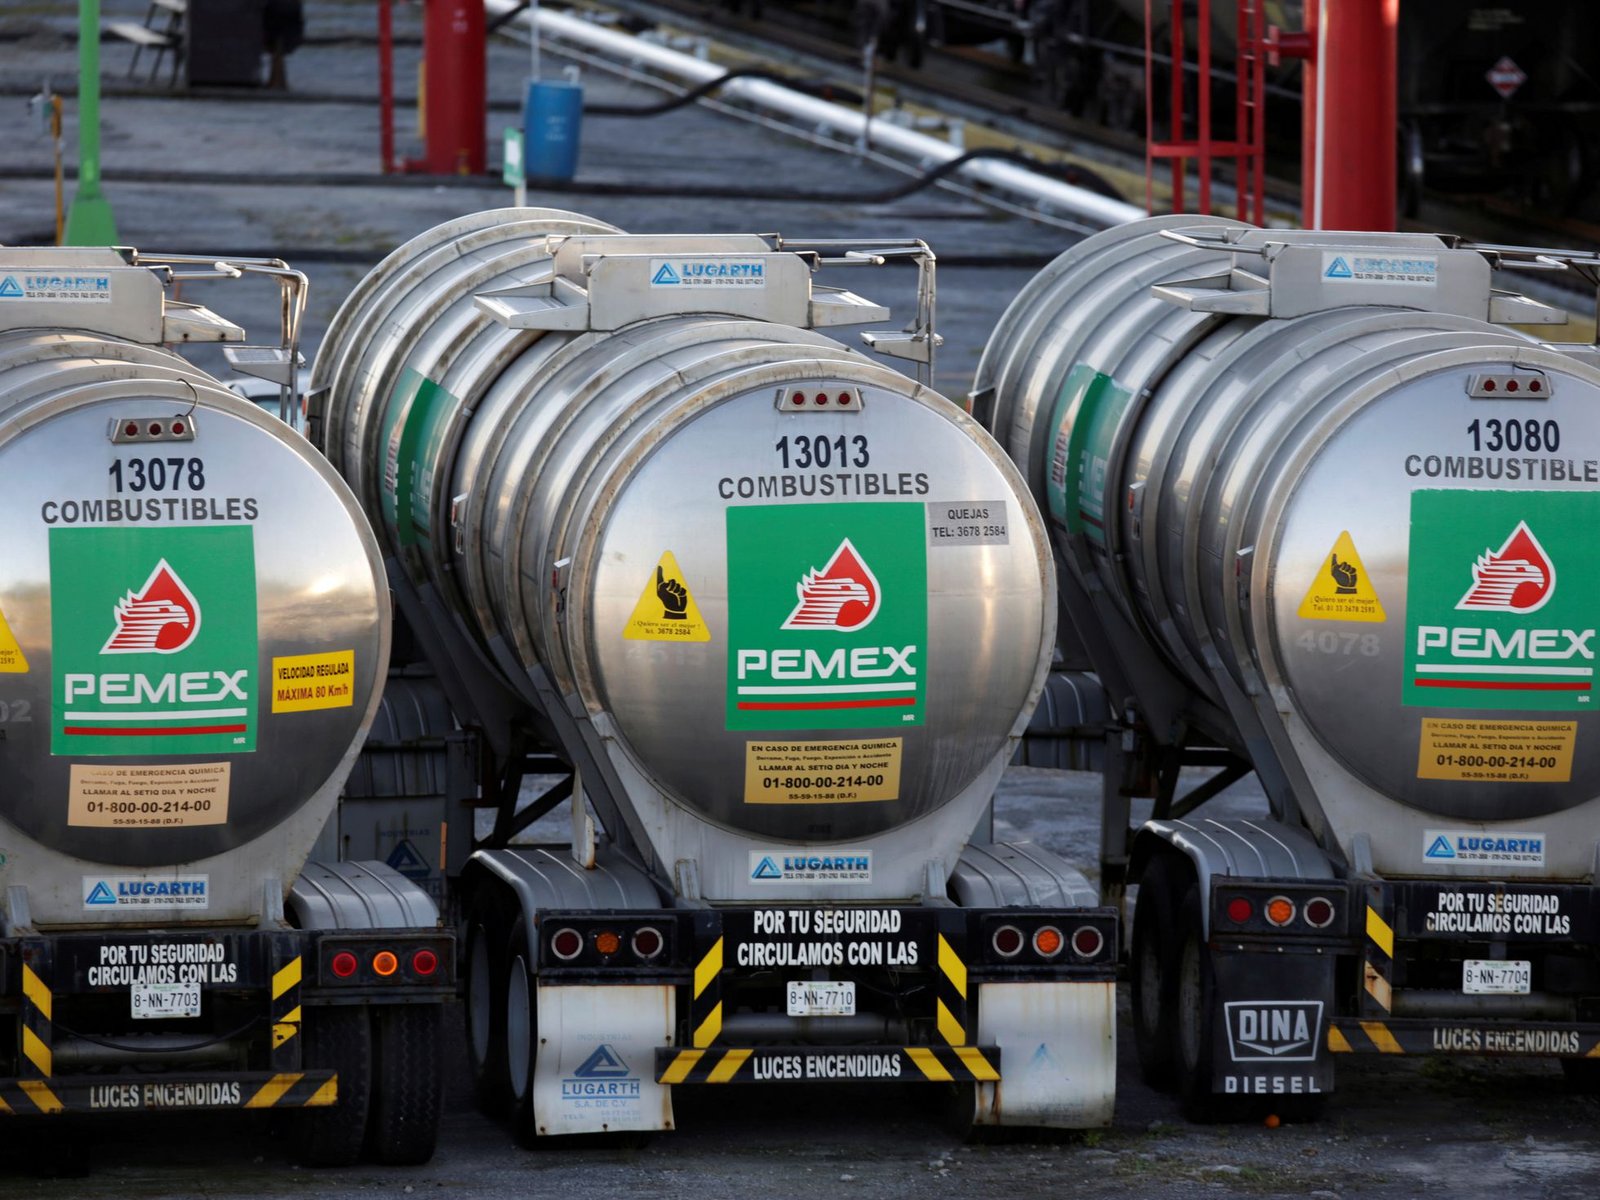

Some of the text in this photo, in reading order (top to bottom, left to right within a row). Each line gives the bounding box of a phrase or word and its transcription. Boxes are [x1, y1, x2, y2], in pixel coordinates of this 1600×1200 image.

[682, 264, 763, 276] LUGARTH
[1467, 419, 1560, 453] 13080
[776, 434, 870, 469] 13013
[109, 458, 206, 493] 13078
[1405, 455, 1599, 482] COMBUSTIBLE
[718, 473, 929, 499] COMBUSTIBLES
[42, 498, 259, 524] COMBUSTIBLES
[948, 508, 989, 520] QUEJAS
[932, 525, 1006, 537] TEL: 3678 2584
[1296, 630, 1380, 656] 4078
[1417, 625, 1596, 659] PEMEX
[279, 662, 349, 679] VELOCIDAD REGULADA
[737, 645, 917, 680] PEMEX
[65, 669, 248, 705] PEMEX
[316, 686, 326, 698] 80
[804, 744, 859, 752] EMERGENCIA
[861, 742, 897, 750] QUIMICA
[130, 769, 186, 777] EMERGENCIA
[188, 767, 225, 775] QUIMICA
[1437, 754, 1556, 768] 01-800-00-214-00
[763, 775, 884, 789] 01-800-00-214-00
[87, 800, 211, 813] 01-800-00-214-00
[836, 792, 857, 800] (D.F.)
[1458, 837, 1541, 853] LUGARTH
[784, 856, 869, 871] LUGARTH
[119, 881, 205, 896] LUGARTH
[1438, 892, 1560, 914] POR TU SEGURIDAD
[753, 909, 901, 934] POR TU SEGURIDAD
[1426, 912, 1571, 934] CIRCULAMOS CON LAS
[100, 943, 225, 965] POR TU SEGURIDAD
[737, 941, 918, 966] CIRCULAMOS CON LAS
[88, 963, 237, 986] CIRCULAMOS CON LAS
[1466, 969, 1529, 984] 8-NN-7704
[134, 993, 198, 1008] 8-NN-7703
[790, 991, 853, 1005] 8-NN-7710
[1239, 1009, 1310, 1041] DINA
[1433, 1027, 1580, 1053] LUCES ENCENDIDAS
[753, 1054, 901, 1080] LUCES ENCENDIDAS
[90, 1082, 241, 1108] LUCES ENCENDIDAS
[562, 1082, 640, 1095] LUGARTH
[1225, 1075, 1322, 1094] DIESEL
